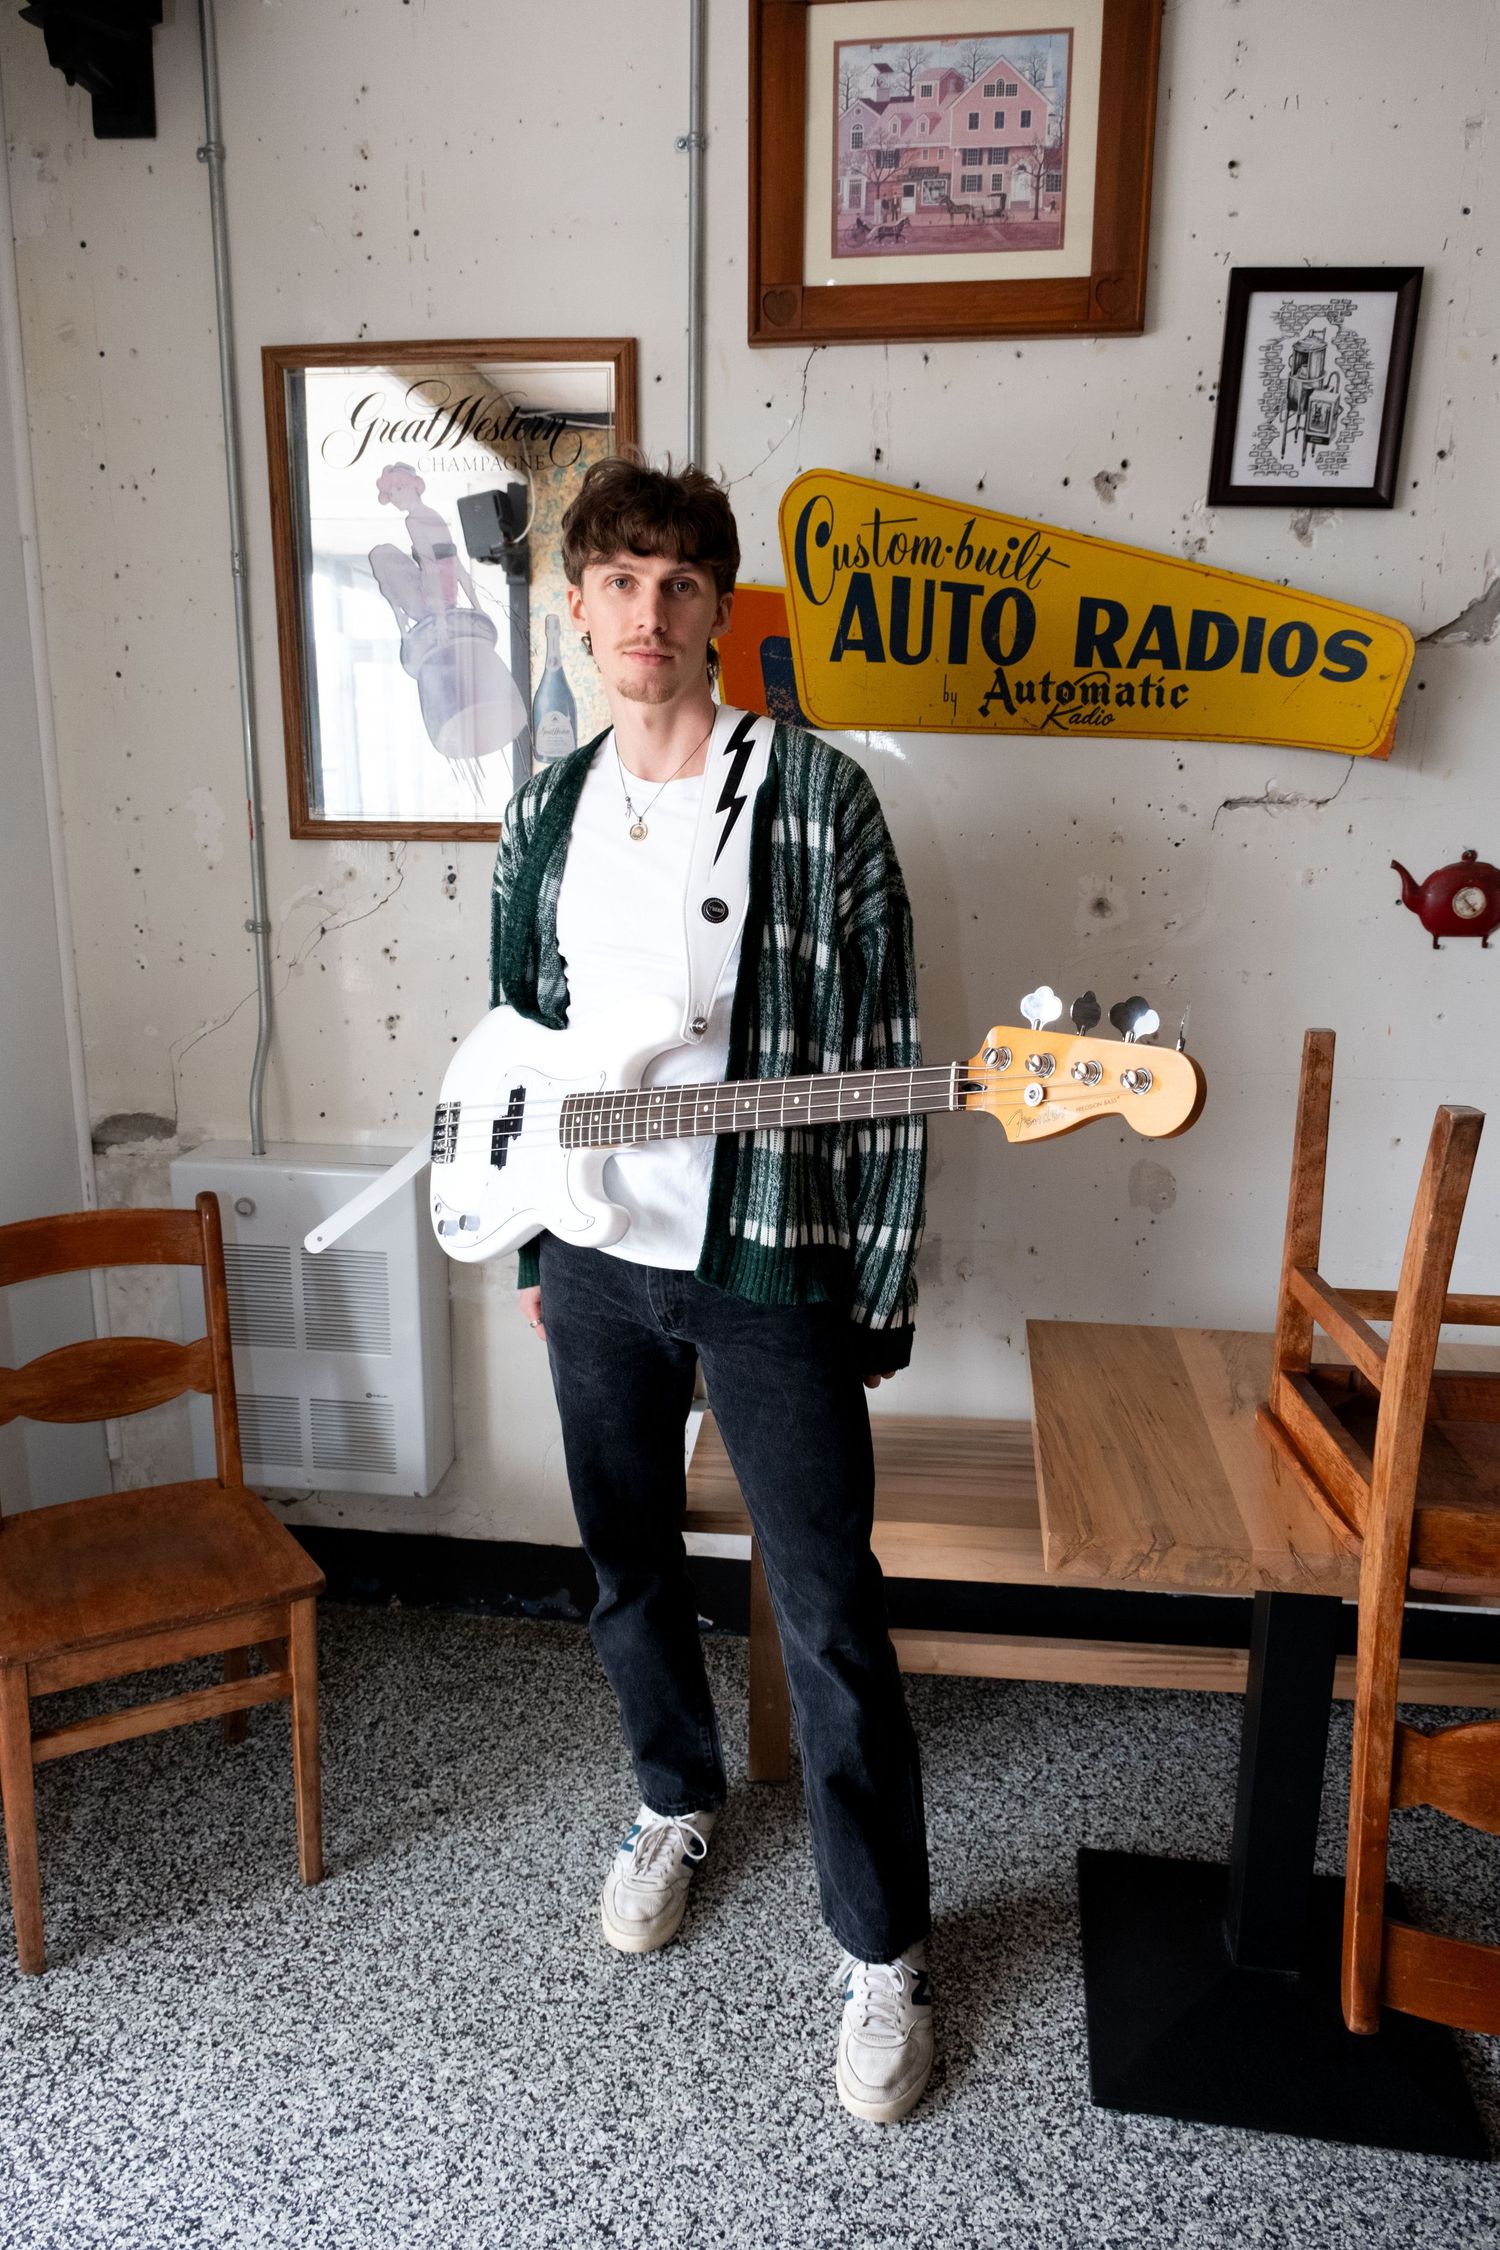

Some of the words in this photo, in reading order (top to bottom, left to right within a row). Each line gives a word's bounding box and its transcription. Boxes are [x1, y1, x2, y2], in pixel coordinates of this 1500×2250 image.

[321, 390, 447, 469] Great
[405, 379, 582, 468] Western
[417, 454, 546, 473] CHAMPAGNE
[829, 571, 1037, 667] AUTO
[1074, 596, 1374, 683] RADIOS
[943, 673, 958, 718] by
[978, 667, 1190, 718] Automatic
[1040, 703, 1116, 731] Radio
